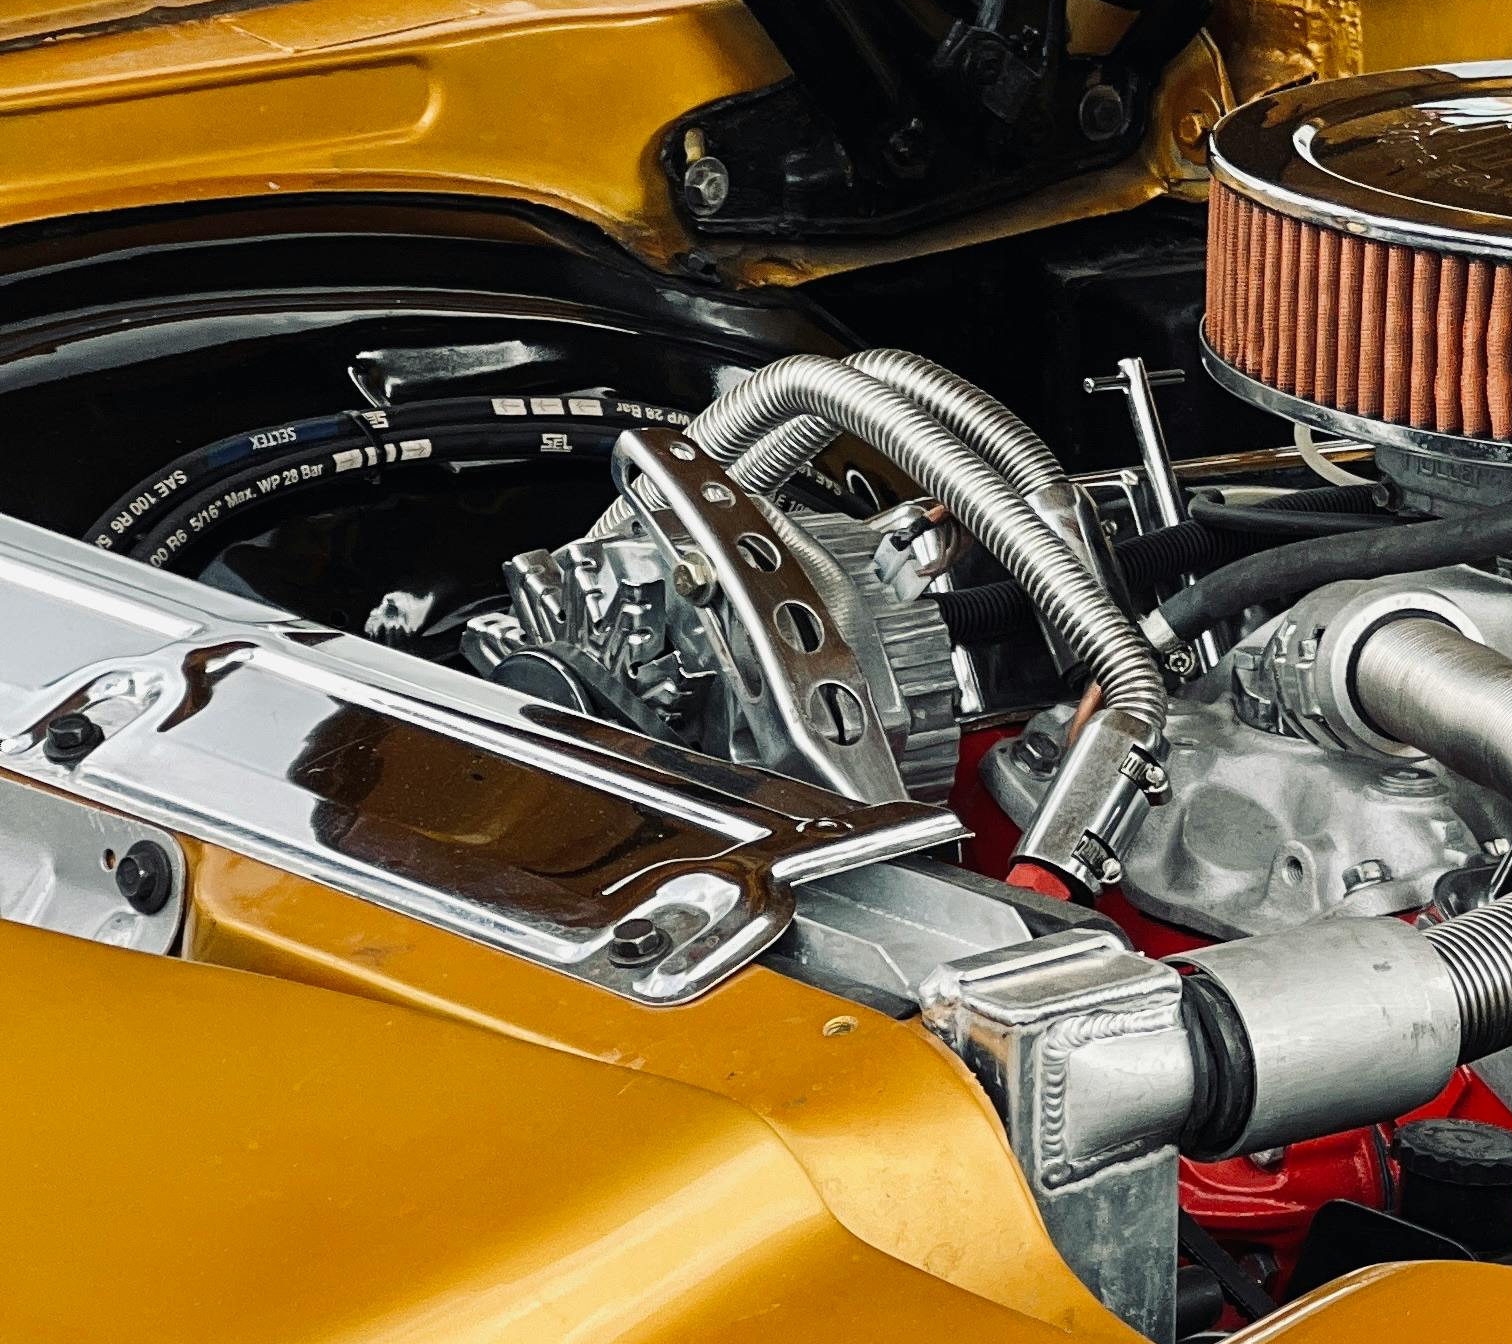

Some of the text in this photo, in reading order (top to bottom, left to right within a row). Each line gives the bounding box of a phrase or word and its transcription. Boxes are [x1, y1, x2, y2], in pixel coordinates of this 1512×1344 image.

[361, 410, 390, 429] SE
[616, 402, 690, 427] WP 28 Bar
[249, 426, 297, 450] SELTEX
[540, 433, 573, 453] SEL
[153, 470, 188, 498] SAE
[129, 492, 157, 516] 100
[149, 463, 324, 568] 00 R6 5/16" Max. WP 28 Bar
[110, 511, 134, 534] R6
